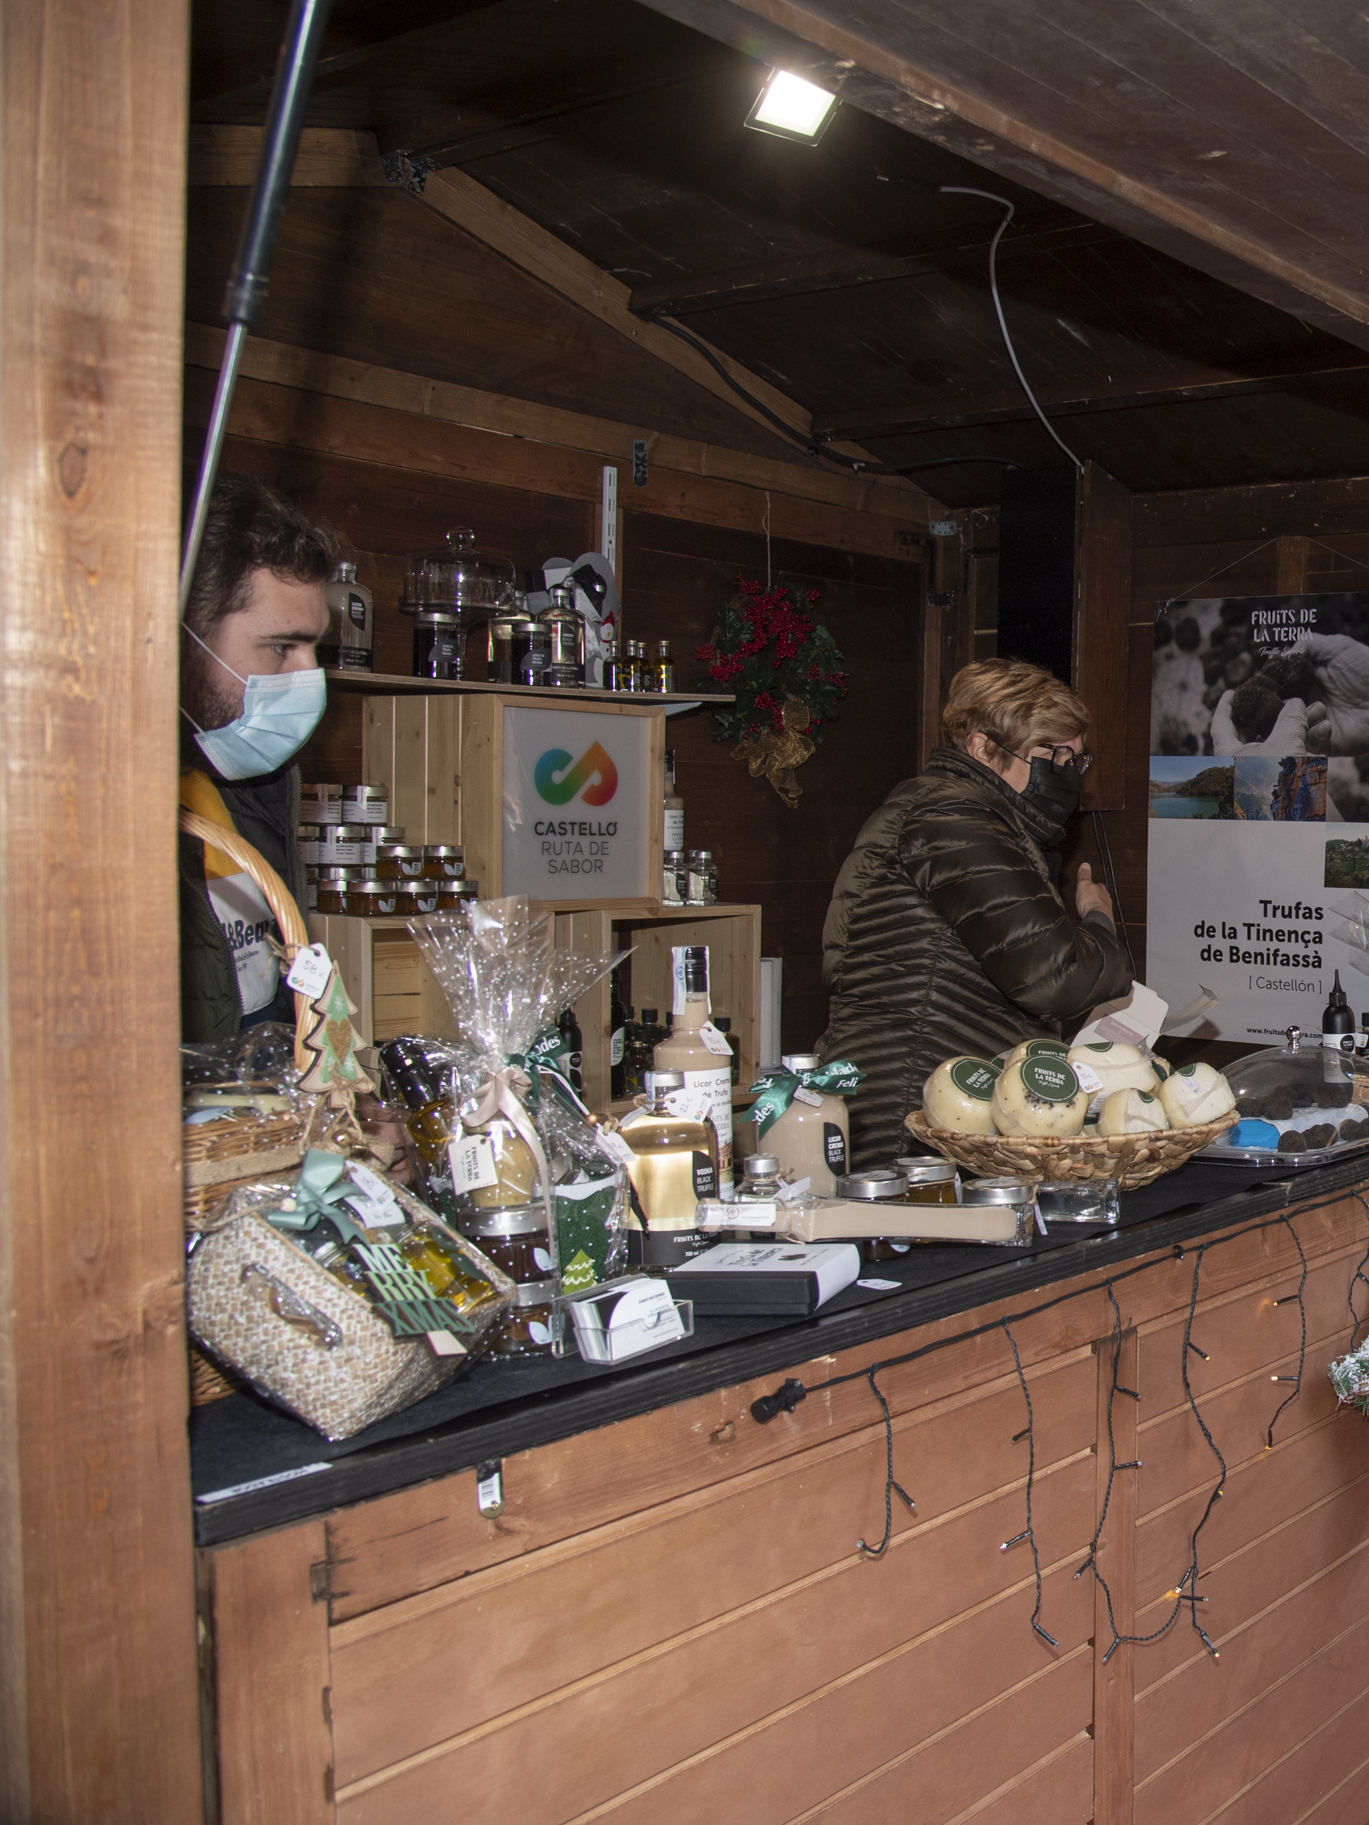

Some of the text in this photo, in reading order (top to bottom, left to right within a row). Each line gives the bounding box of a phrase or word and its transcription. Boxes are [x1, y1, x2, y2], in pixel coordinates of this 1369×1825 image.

[1300, 608, 1317, 624] DE
[1253, 626, 1314, 642] LA TERRA
[534, 821, 618, 836] CASTELLÓ
[541, 841, 610, 856] RUTA DE
[548, 859, 604, 874] SABOR
[1258, 899, 1324, 921] Trufas
[1193, 920, 1323, 949] de la Tinença
[1200, 944, 1322, 969] de Benifassà
[1256, 976, 1315, 992] Castellón
[1045, 1076, 1064, 1085] TERRA
[1057, 1072, 1066, 1080] DE
[694, 1080, 712, 1088] Licor
[829, 1155, 844, 1163] TRUFFLE
[696, 1167, 713, 1176] VODKA
[697, 1176, 711, 1184] BLACK
[697, 1183, 714, 1192] TRUFFLE
[373, 1297, 476, 1336] XMAS
